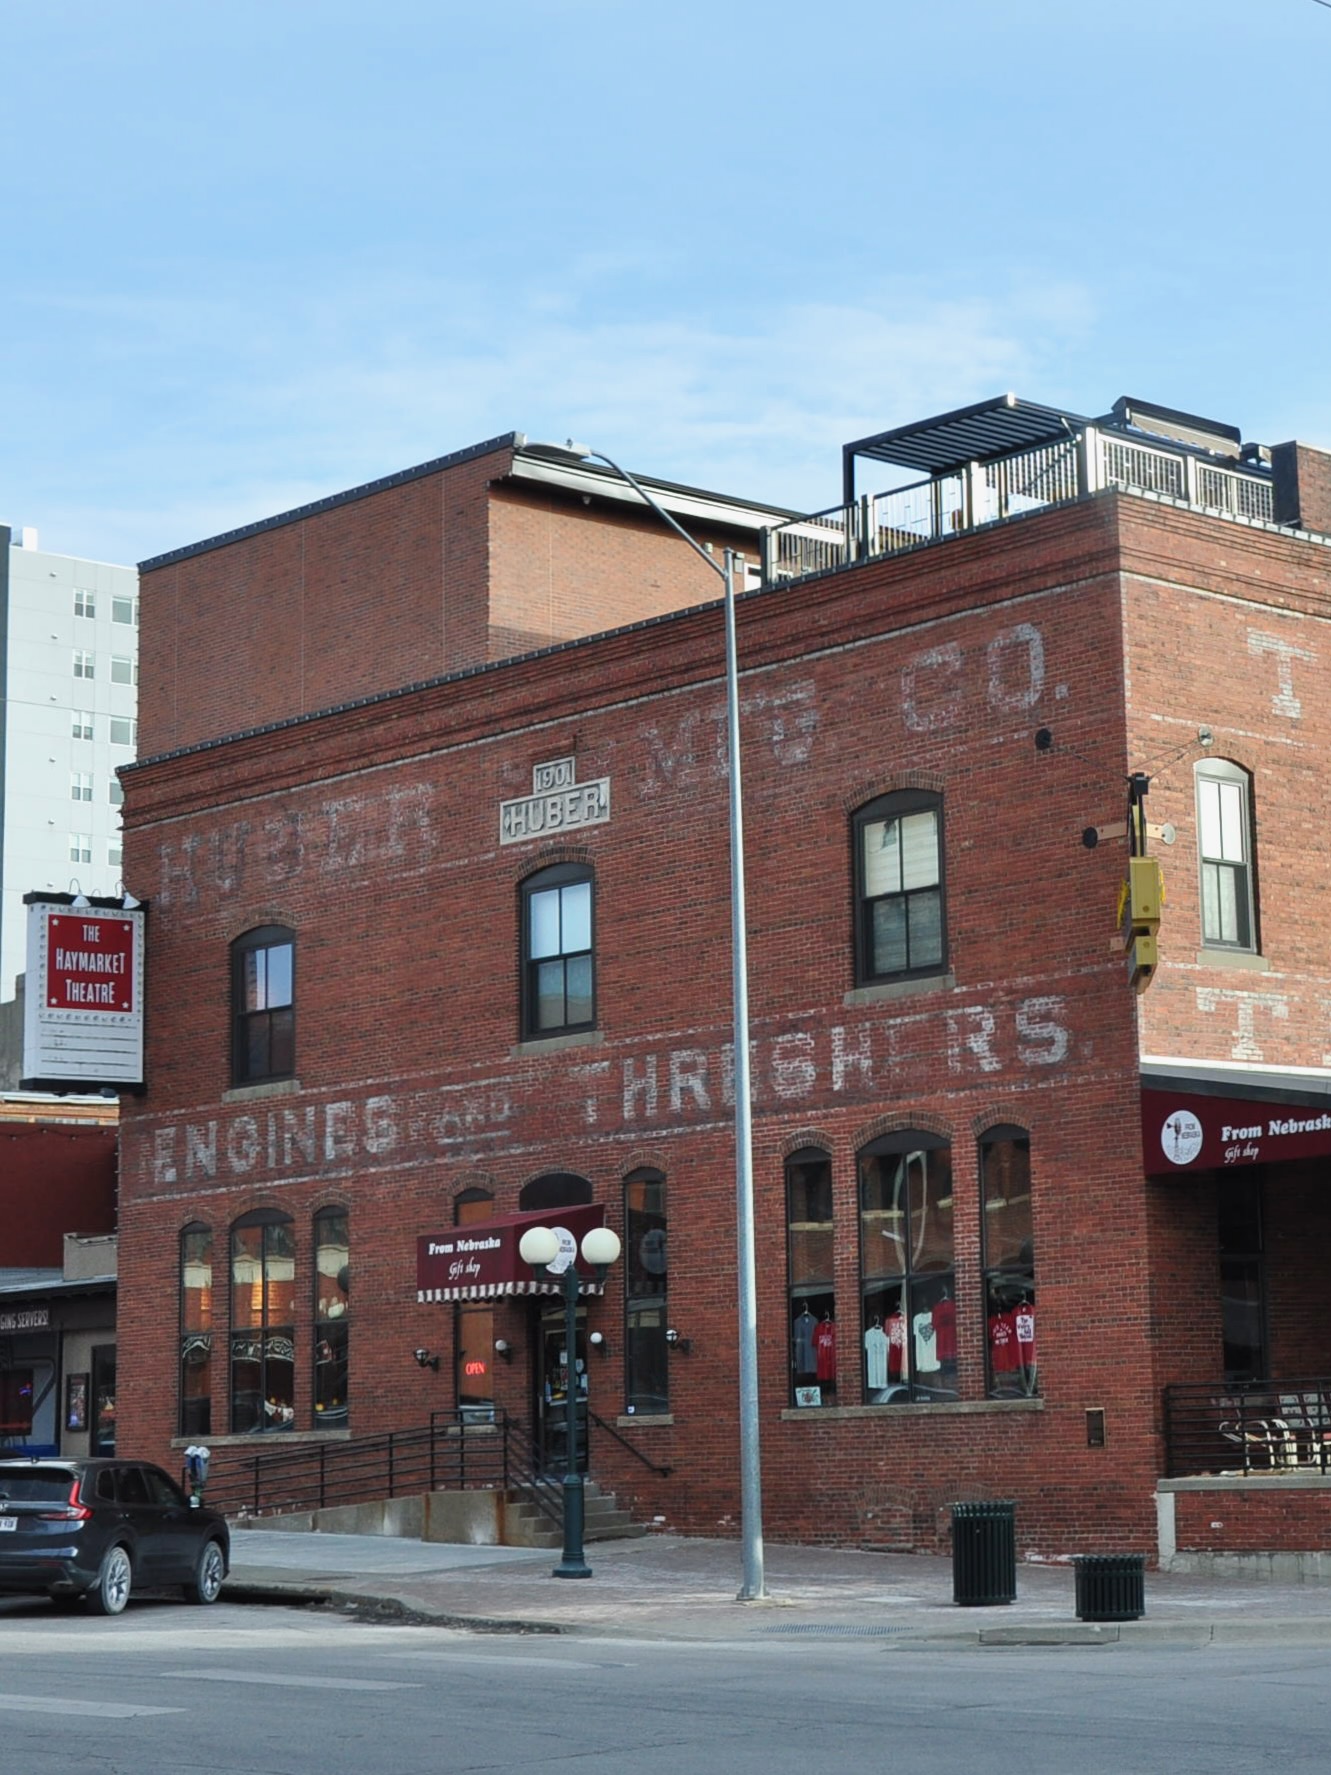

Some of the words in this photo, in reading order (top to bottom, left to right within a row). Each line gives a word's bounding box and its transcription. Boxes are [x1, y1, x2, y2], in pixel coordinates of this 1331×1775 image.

[536, 761, 573, 792] 1901
[509, 786, 602, 838] HUBER
[82, 924, 100, 943] THE
[56, 948, 126, 975] HAYMARKET
[65, 979, 116, 1004] THEATRE
[149, 1094, 399, 1184] ENGINES
[1221, 1126, 1263, 1142] From
[1224, 1144, 1241, 1164] Gift
[1242, 1142, 1260, 1160] shop
[428, 1242, 454, 1256] From
[456, 1237, 501, 1253] Nebraska
[448, 1258, 464, 1280] Gift
[465, 1256, 481, 1277] shop
[465, 1360, 487, 1376] OPEN
